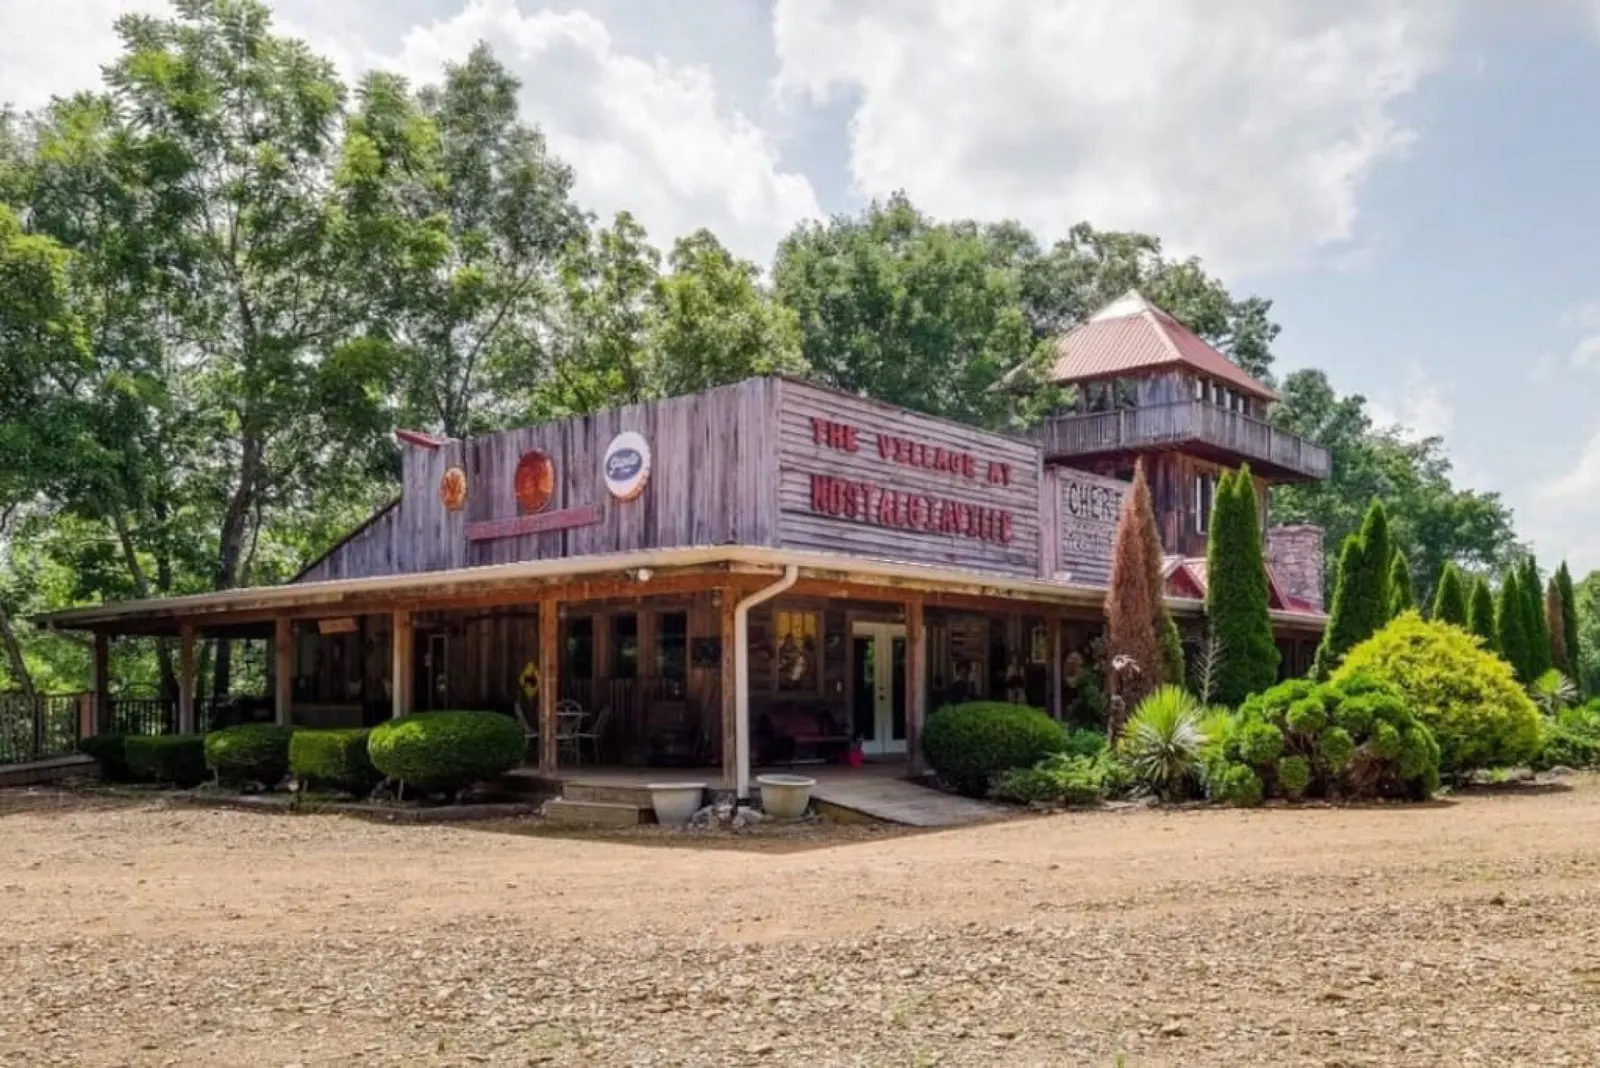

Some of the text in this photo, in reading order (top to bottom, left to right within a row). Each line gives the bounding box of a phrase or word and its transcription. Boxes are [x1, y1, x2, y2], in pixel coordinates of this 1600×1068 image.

[811, 416, 1011, 486] THE VILLAGE AT
[810, 473, 1013, 546] NOSTALGIAVILLE
